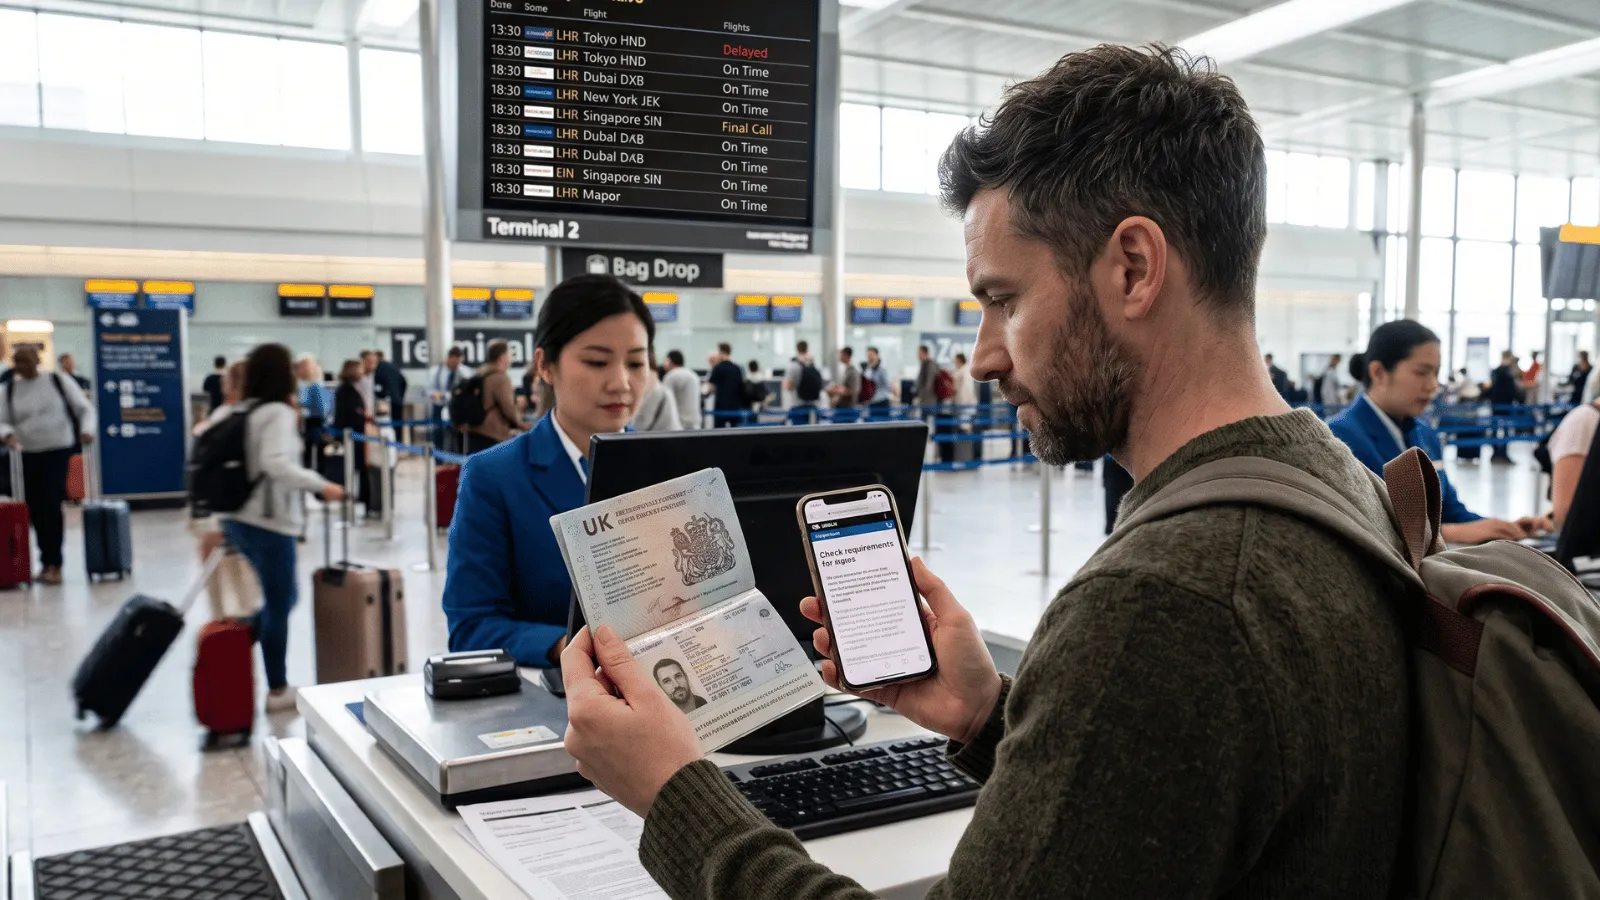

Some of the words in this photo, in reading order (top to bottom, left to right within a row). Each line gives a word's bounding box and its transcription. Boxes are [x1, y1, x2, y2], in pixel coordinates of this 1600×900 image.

[524, 3, 548, 12] Some
[584, 8, 607, 19] Flight
[724, 22, 750, 32] Flights
[491, 24, 521, 36] 13:30
[556, 30, 579, 42] LHR
[583, 32, 617, 46] Tokyo
[620, 35, 646, 47] HND
[723, 44, 768, 59] Delayed
[491, 44, 521, 56] 18:30
[556, 49, 579, 61] LHR
[583, 52, 617, 66] Tokyo
[620, 55, 646, 67] HND
[723, 64, 739, 75] On
[742, 65, 769, 78] Time
[491, 64, 521, 76] 18:30
[556, 69, 579, 80] LHR
[583, 71, 617, 84] Dubai
[620, 74, 644, 86] DXB
[722, 83, 738, 94] On
[742, 85, 769, 97] Time
[491, 84, 521, 96] 18:30
[556, 88, 579, 100] LHR
[583, 91, 609, 102] New
[612, 93, 638, 106] York
[641, 95, 660, 107] JEK
[722, 102, 738, 113] On
[742, 104, 768, 116] Time
[491, 104, 521, 116] 18:30
[556, 108, 579, 120] LHR
[583, 110, 641, 125] Singapore
[644, 115, 662, 127] SIN
[722, 121, 748, 133] Final
[752, 124, 772, 135] Call
[491, 124, 521, 136] 18:30
[556, 128, 579, 140] LHR
[722, 141, 738, 152] On
[741, 142, 768, 154] Time
[491, 144, 521, 155] 18:30
[556, 148, 579, 159] LHR
[721, 160, 738, 171] On
[741, 161, 768, 173] Time
[491, 163, 521, 175] 18:30
[556, 168, 574, 178] EIN
[583, 169, 640, 184] Singapore
[644, 173, 662, 185] SIN
[721, 180, 737, 190] On
[741, 181, 768, 192] Time
[491, 183, 521, 194] 18:30
[556, 187, 579, 199] LHR
[583, 189, 621, 203] Mapor
[721, 199, 737, 209] On
[741, 200, 768, 212] Time
[487, 216, 564, 238] Terminal
[568, 221, 580, 239] 2
[613, 257, 650, 282] Bag
[654, 258, 700, 282] Drop
[395, 332, 533, 363] Temial
[582, 513, 614, 536] UK
[820, 549, 843, 558] Check
[845, 541, 894, 556] requirements
